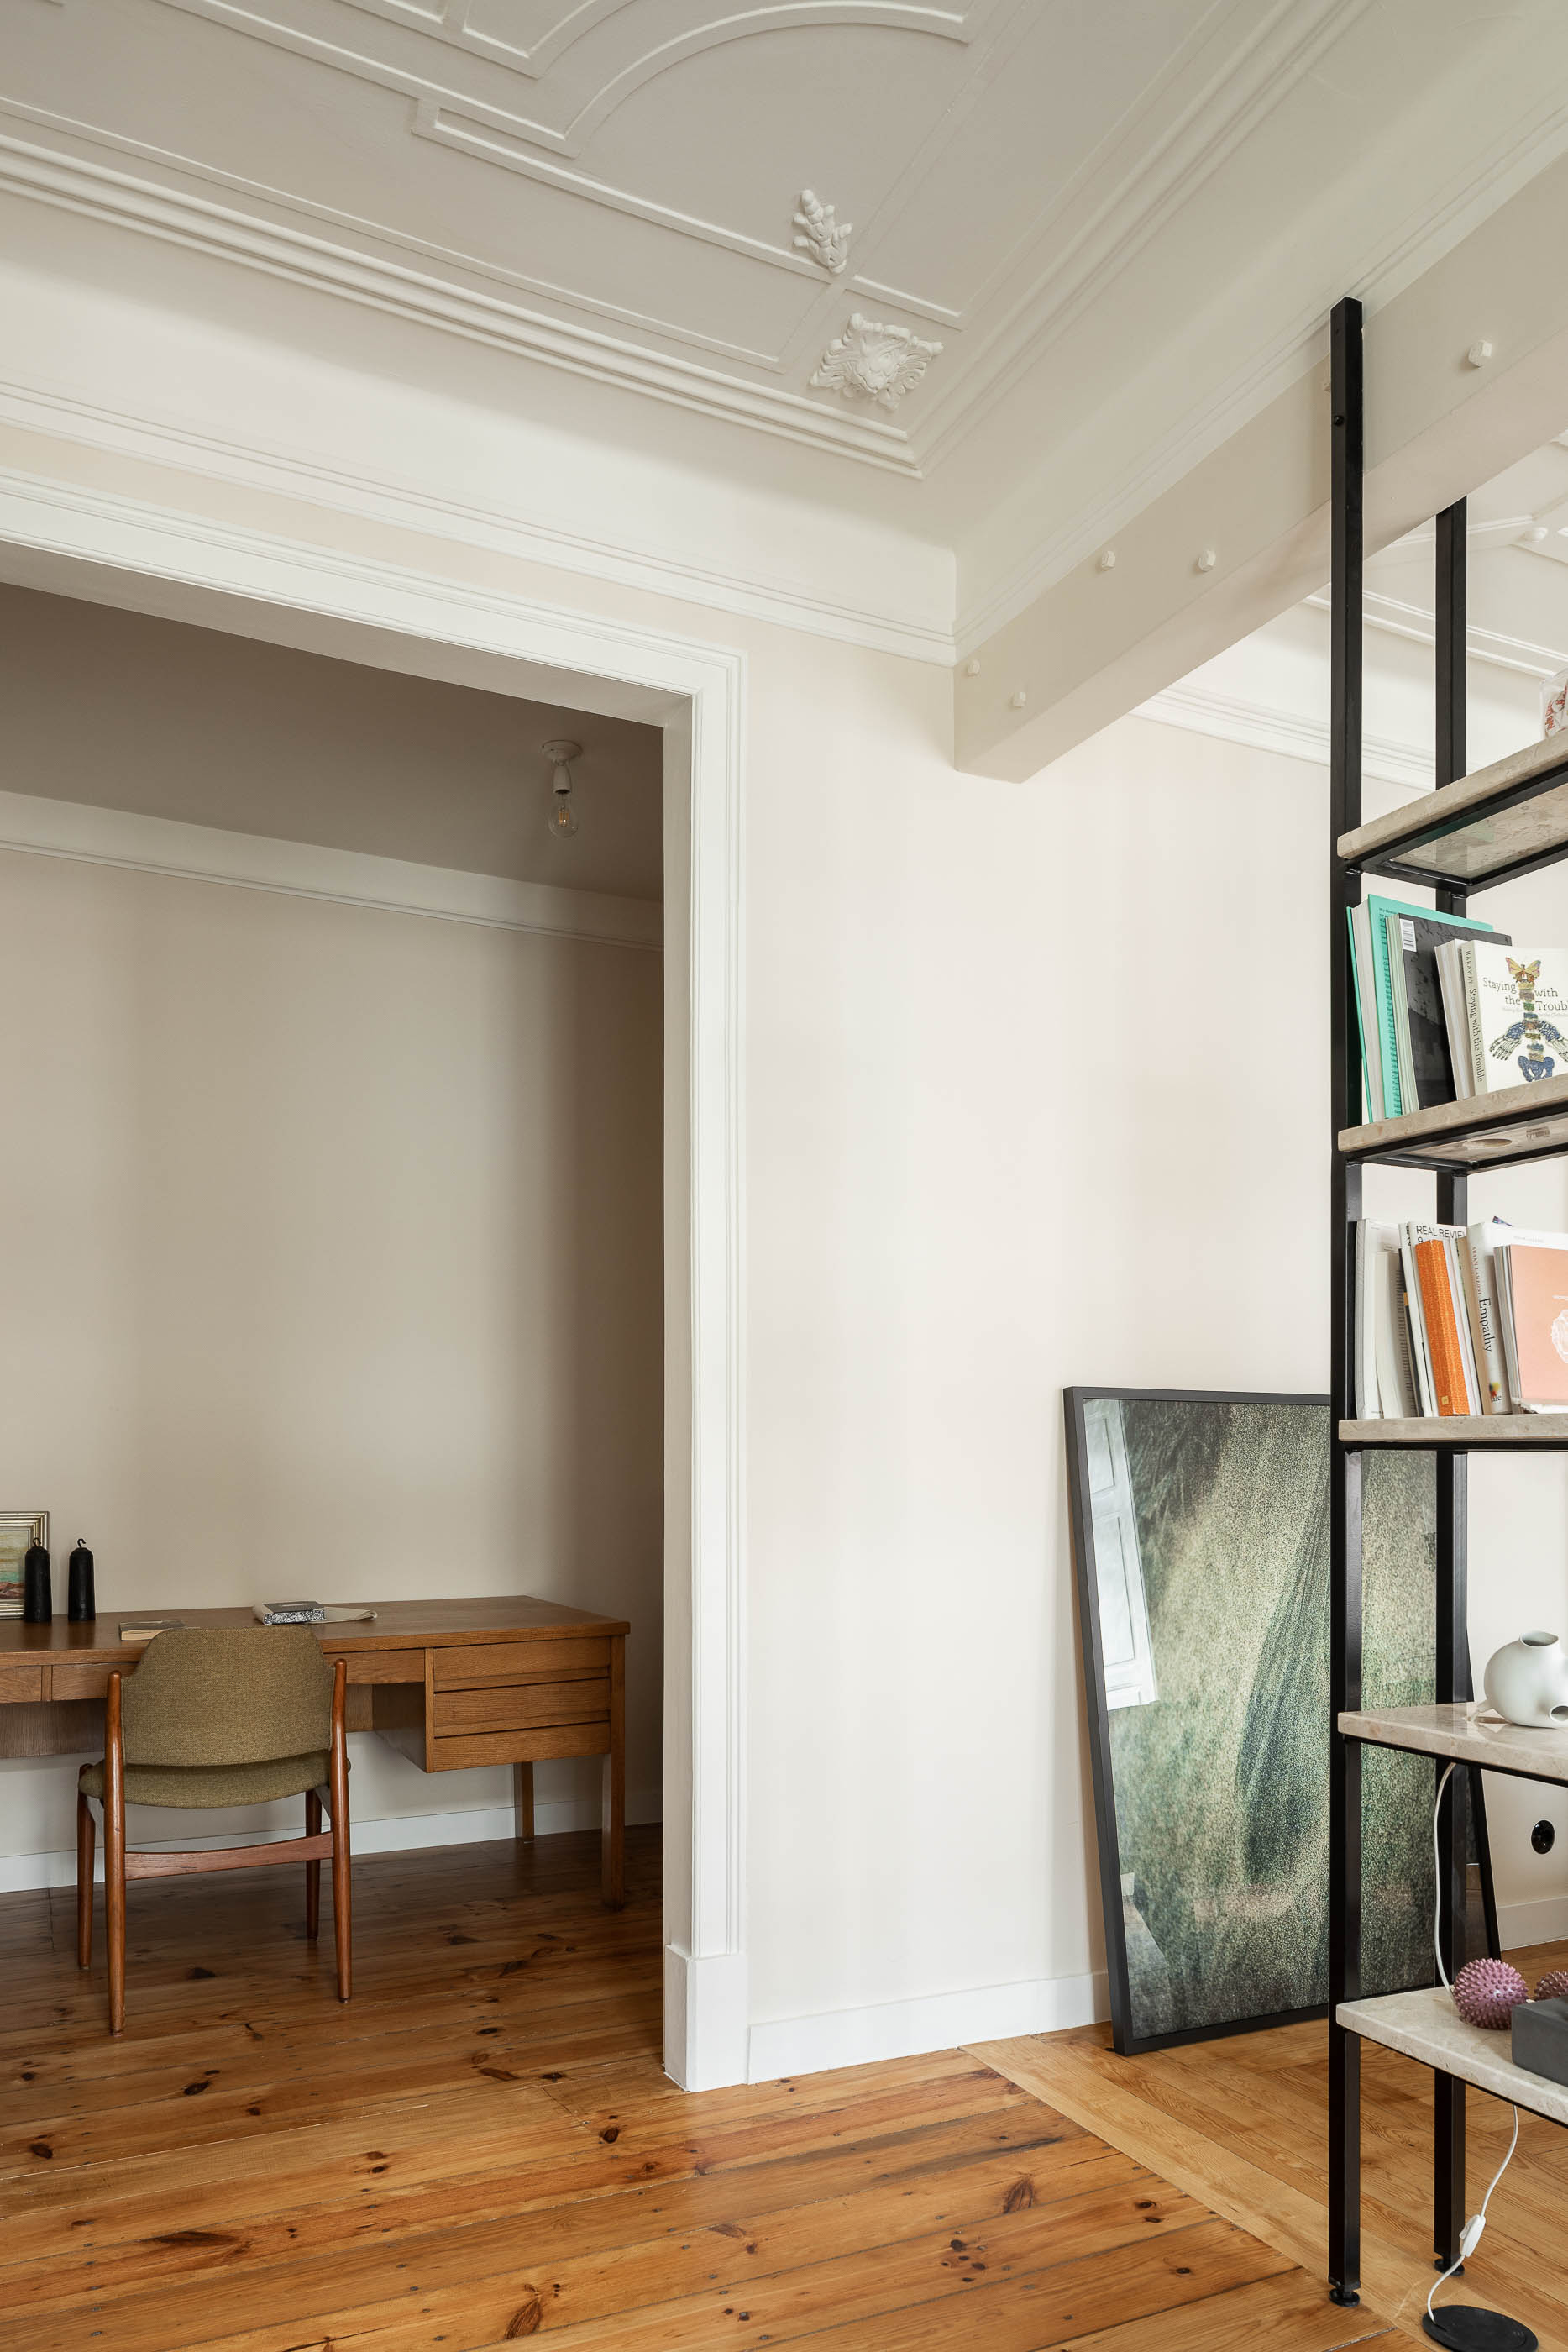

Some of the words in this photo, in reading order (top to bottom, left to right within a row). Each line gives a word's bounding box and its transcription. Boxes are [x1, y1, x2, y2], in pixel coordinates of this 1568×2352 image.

[1466, 950, 1474, 984] HARAWAY
[1482, 977, 1517, 994] Staying
[1534, 988, 1558, 997] with
[1468, 988, 1478, 1019] Staying
[1505, 995, 1521, 1005] the
[1472, 1018, 1481, 1037] with
[1476, 1051, 1485, 1082] Trouble
[1416, 1226, 1438, 1237] REAL
[1479, 1297, 1495, 1352] Empathy
